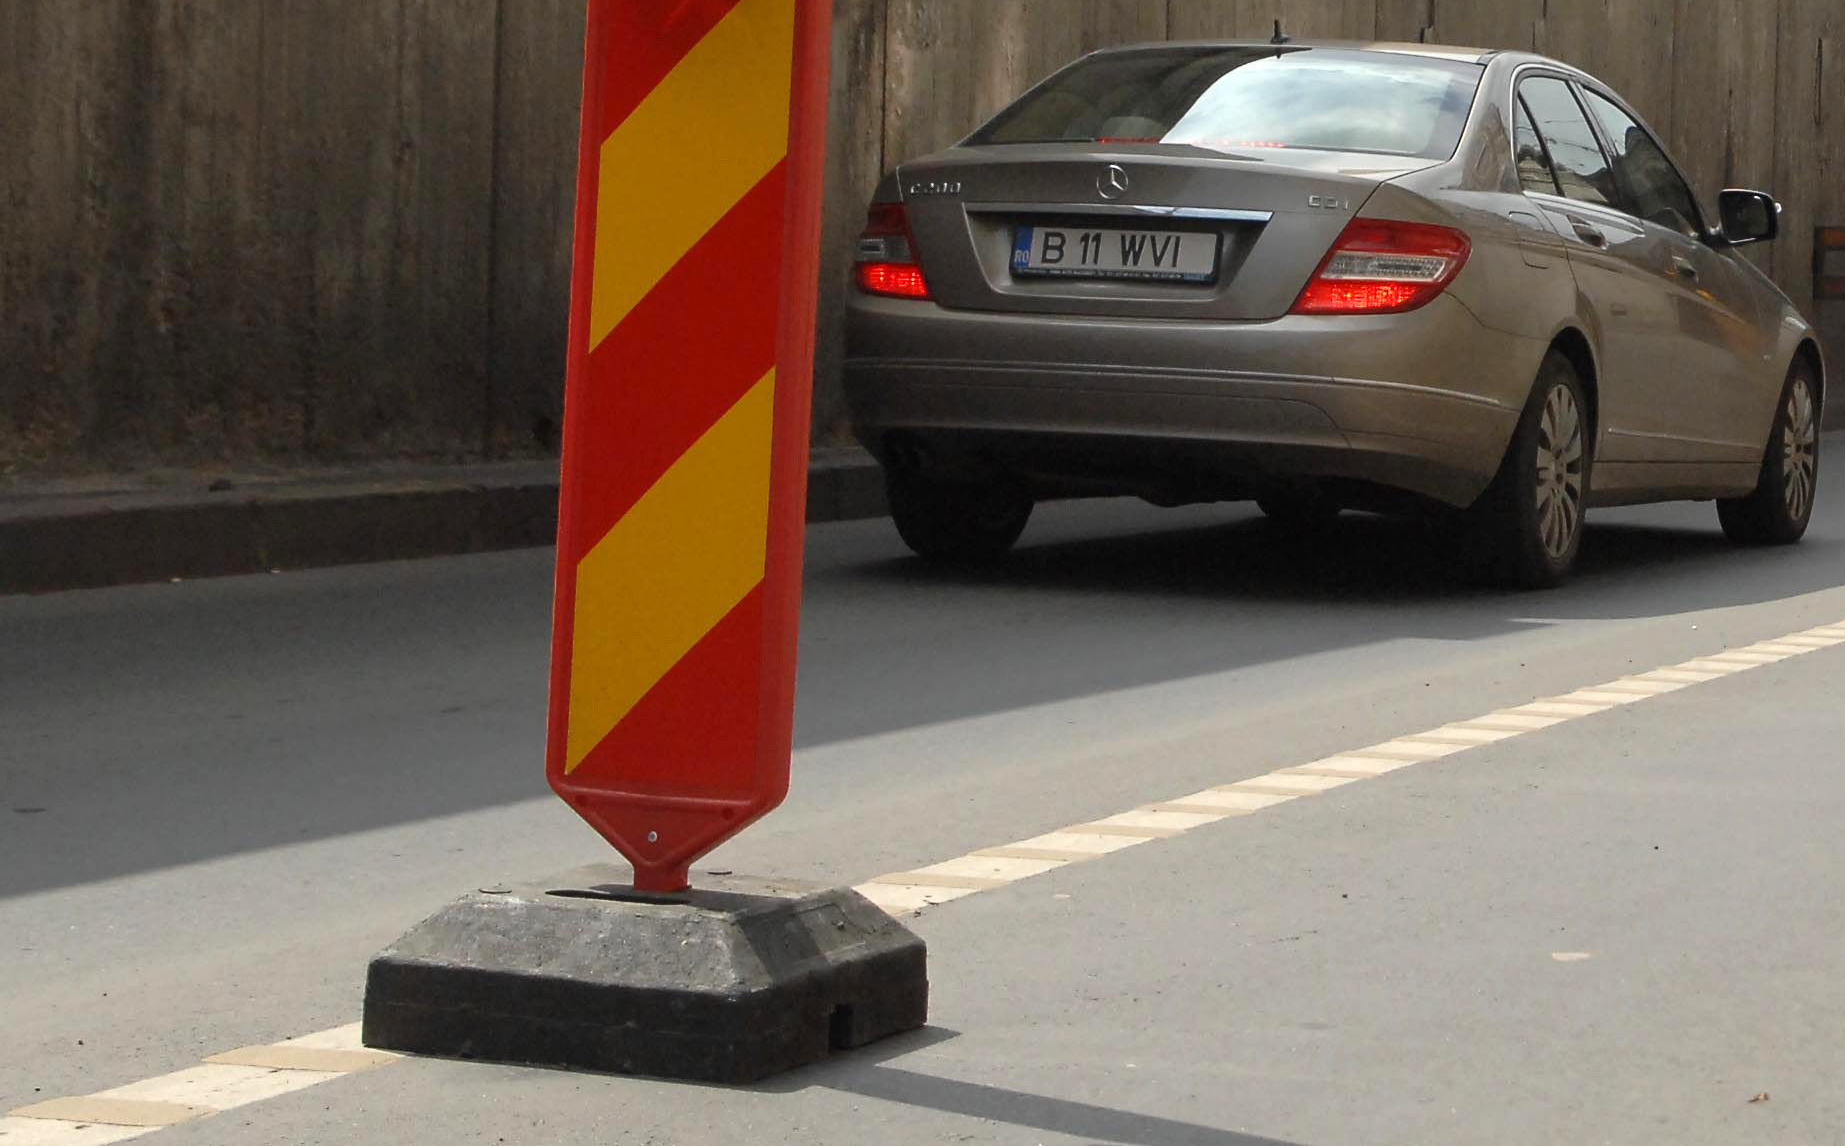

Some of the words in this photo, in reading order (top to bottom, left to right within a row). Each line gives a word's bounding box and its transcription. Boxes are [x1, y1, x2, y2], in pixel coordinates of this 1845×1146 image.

[1041, 231, 1066, 265] B
[1079, 232, 1101, 266] 11
[1121, 234, 1181, 268] WVI
